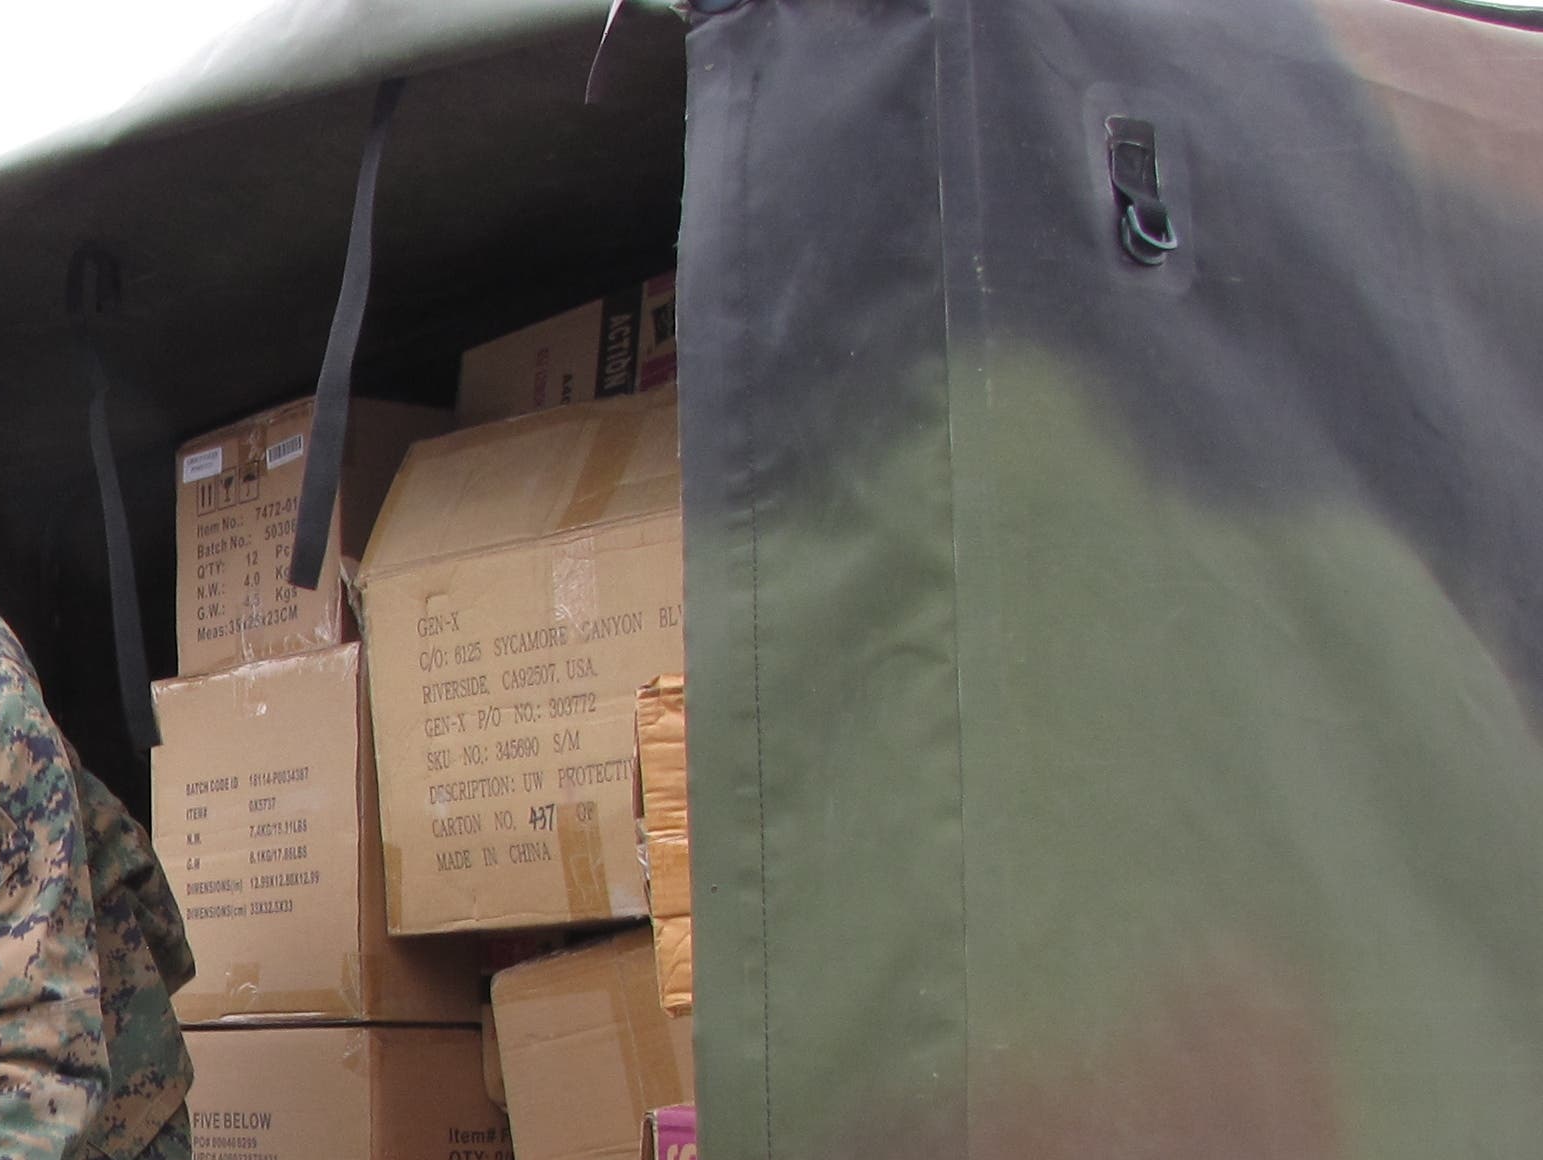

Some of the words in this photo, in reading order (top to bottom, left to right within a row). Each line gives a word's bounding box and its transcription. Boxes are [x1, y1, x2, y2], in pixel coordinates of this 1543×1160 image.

[197, 522, 220, 538] Item
[222, 516, 244, 530] No.:
[197, 538, 228, 560] Batch
[246, 550, 259, 567] 12
[275, 544, 292, 559] Pc
[243, 571, 260, 587] 4.0
[417, 611, 461, 638] GEN-X
[419, 651, 450, 673] C/O:
[454, 641, 482, 665] 6125
[494, 626, 568, 657] SYCAMORE
[581, 611, 644, 642] CANYON
[659, 604, 682, 627] BL
[424, 713, 466, 738] GEN-X
[478, 705, 502, 732] P/O
[549, 692, 598, 719] 303772
[427, 750, 452, 772] SKU
[554, 730, 582, 754] S/M
[186, 780, 209, 796] BATCH
[210, 777, 230, 793] CODE
[429, 774, 516, 806] DESCRIPTION:
[523, 771, 545, 793] UW
[558, 757, 636, 789] PROTECTIV
[432, 813, 482, 838] CARTON
[436, 848, 472, 872] MADE
[484, 847, 498, 867] IN
[509, 841, 553, 865] CHINA
[193, 1112, 220, 1129] FIVE
[224, 1112, 272, 1131] BELOW
[448, 1128, 497, 1144] Item#
